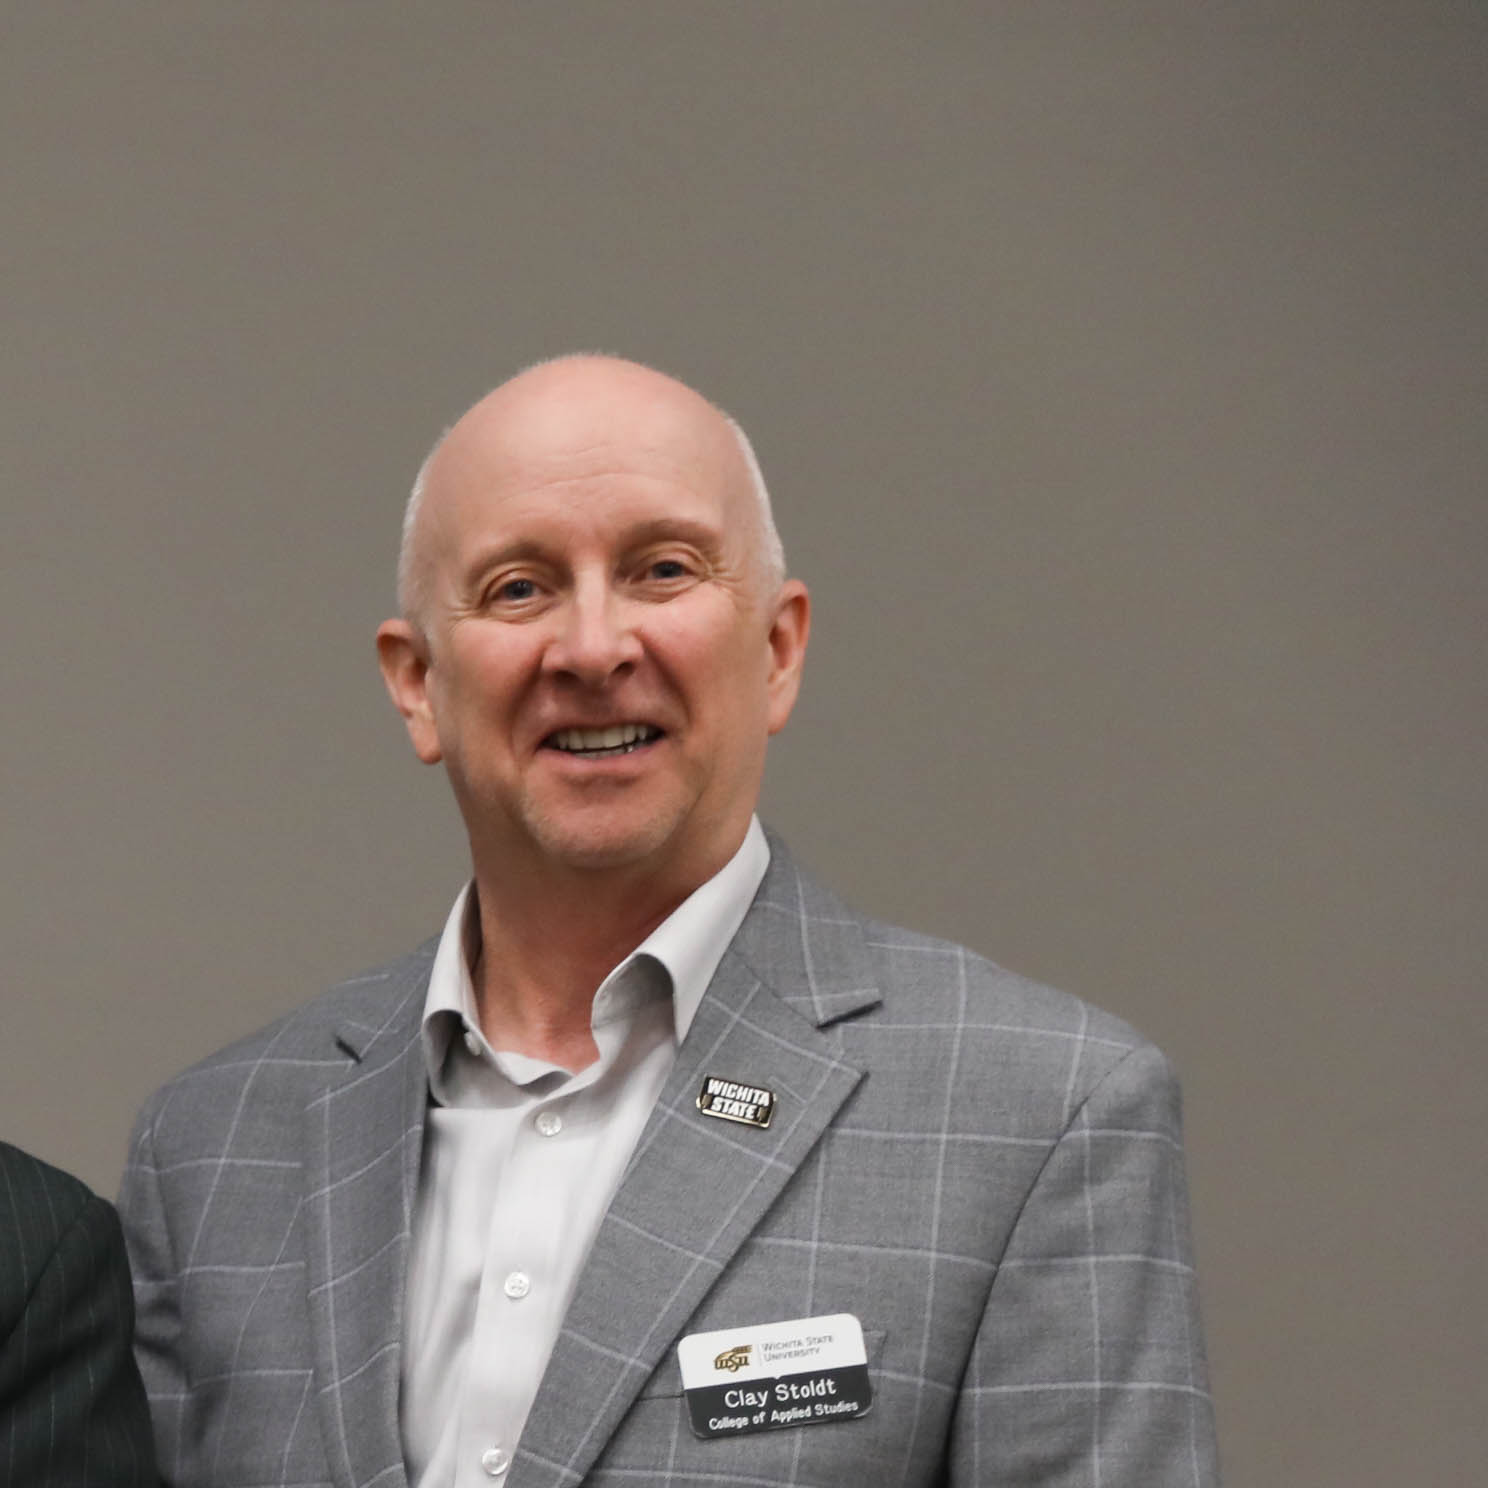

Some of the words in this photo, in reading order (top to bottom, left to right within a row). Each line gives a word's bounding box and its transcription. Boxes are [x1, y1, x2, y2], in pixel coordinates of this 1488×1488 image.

[707, 1079, 770, 1106] WICHITA
[711, 1096, 758, 1119] STATE
[724, 1389, 769, 1409] Clay
[775, 1378, 837, 1402] Stoldt
[708, 1416, 749, 1431] College
[752, 1411, 766, 1425] of
[770, 1406, 812, 1423] Applied
[815, 1400, 859, 1416] Studies
